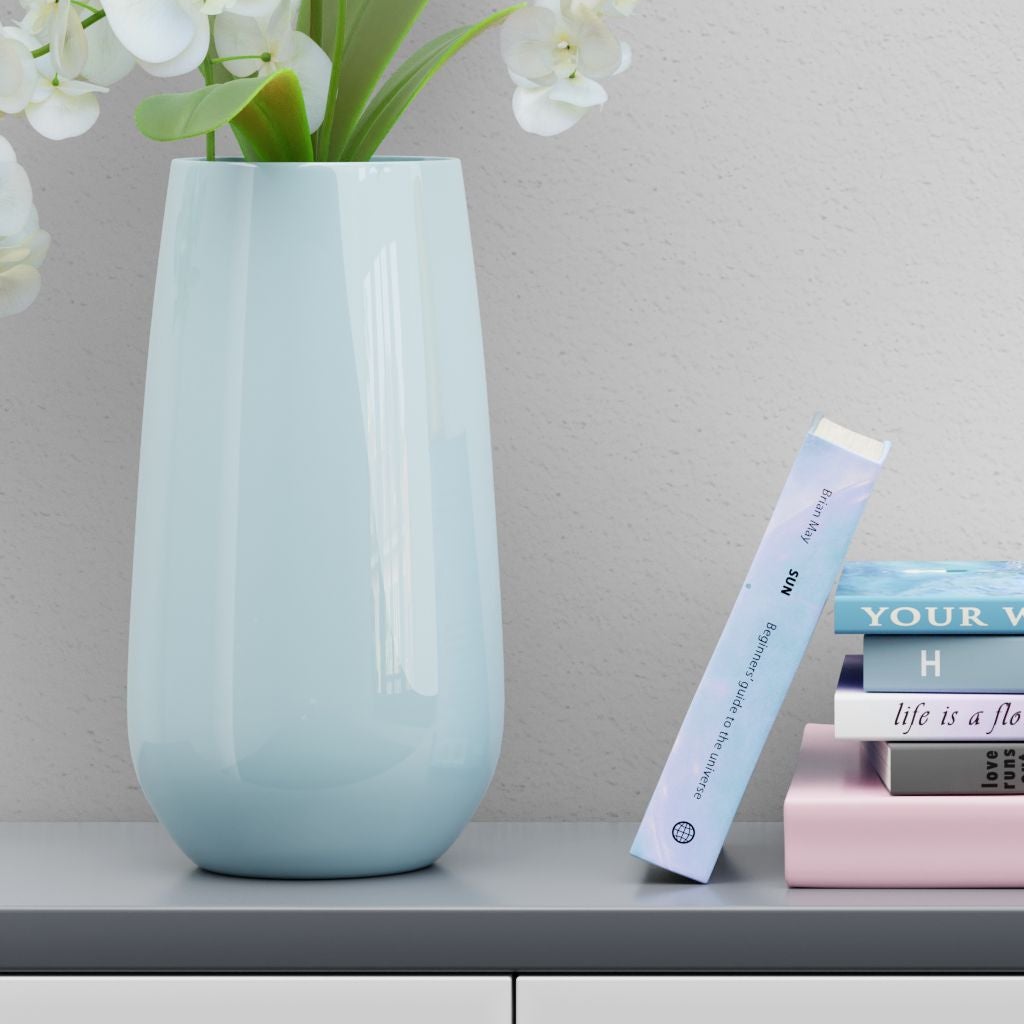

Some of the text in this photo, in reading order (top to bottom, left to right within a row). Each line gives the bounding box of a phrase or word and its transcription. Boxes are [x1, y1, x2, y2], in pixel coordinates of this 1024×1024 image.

[800, 488, 833, 544] Brian May
[780, 568, 799, 597] SUN
[861, 606, 988, 627] YOUR
[729, 680, 749, 714] guide
[723, 715, 735, 728] to
[894, 702, 930, 735] life
[941, 706, 958, 727] is
[968, 711, 981, 726] a
[713, 731, 729, 750] the
[693, 752, 719, 800] universe
[981, 750, 999, 788] love
[1003, 749, 1016, 789] runs
